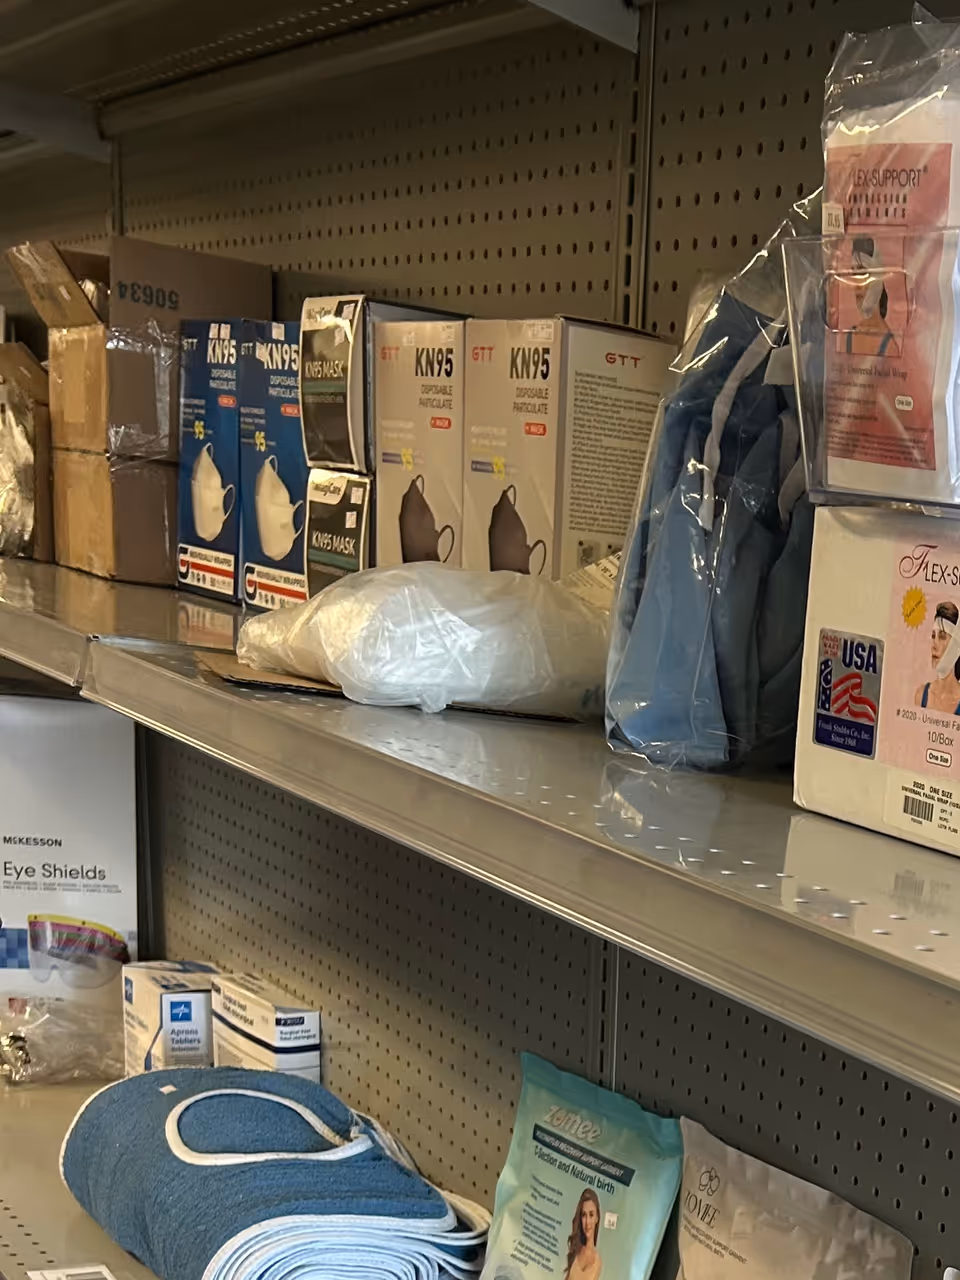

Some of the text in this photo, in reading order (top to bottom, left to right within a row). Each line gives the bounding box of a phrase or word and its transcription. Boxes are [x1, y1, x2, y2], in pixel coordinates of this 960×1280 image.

[207, 339, 236, 364] KN95
[264, 343, 299, 371] KN95
[605, 352, 641, 369] GTT
[415, 347, 453, 378] KN95
[509, 347, 550, 380] KN95
[516, 387, 549, 400] DISPOSABLE
[512, 402, 548, 415] PARTICULATE
[312, 530, 356, 555] KN95 MASK
[842, 638, 878, 674] USA
[902, 709, 917, 721] 2020
[922, 713, 950, 729] Universal
[928, 731, 954, 747] 10/Box
[928, 753, 949, 763] One Size
[929, 786, 940, 796] ONE
[941, 790, 953, 799] SIZE
[3, 861, 107, 881] Eye Shields
[170, 1028, 198, 1038] Aprons
[171, 1037, 201, 1046] Tabliers
